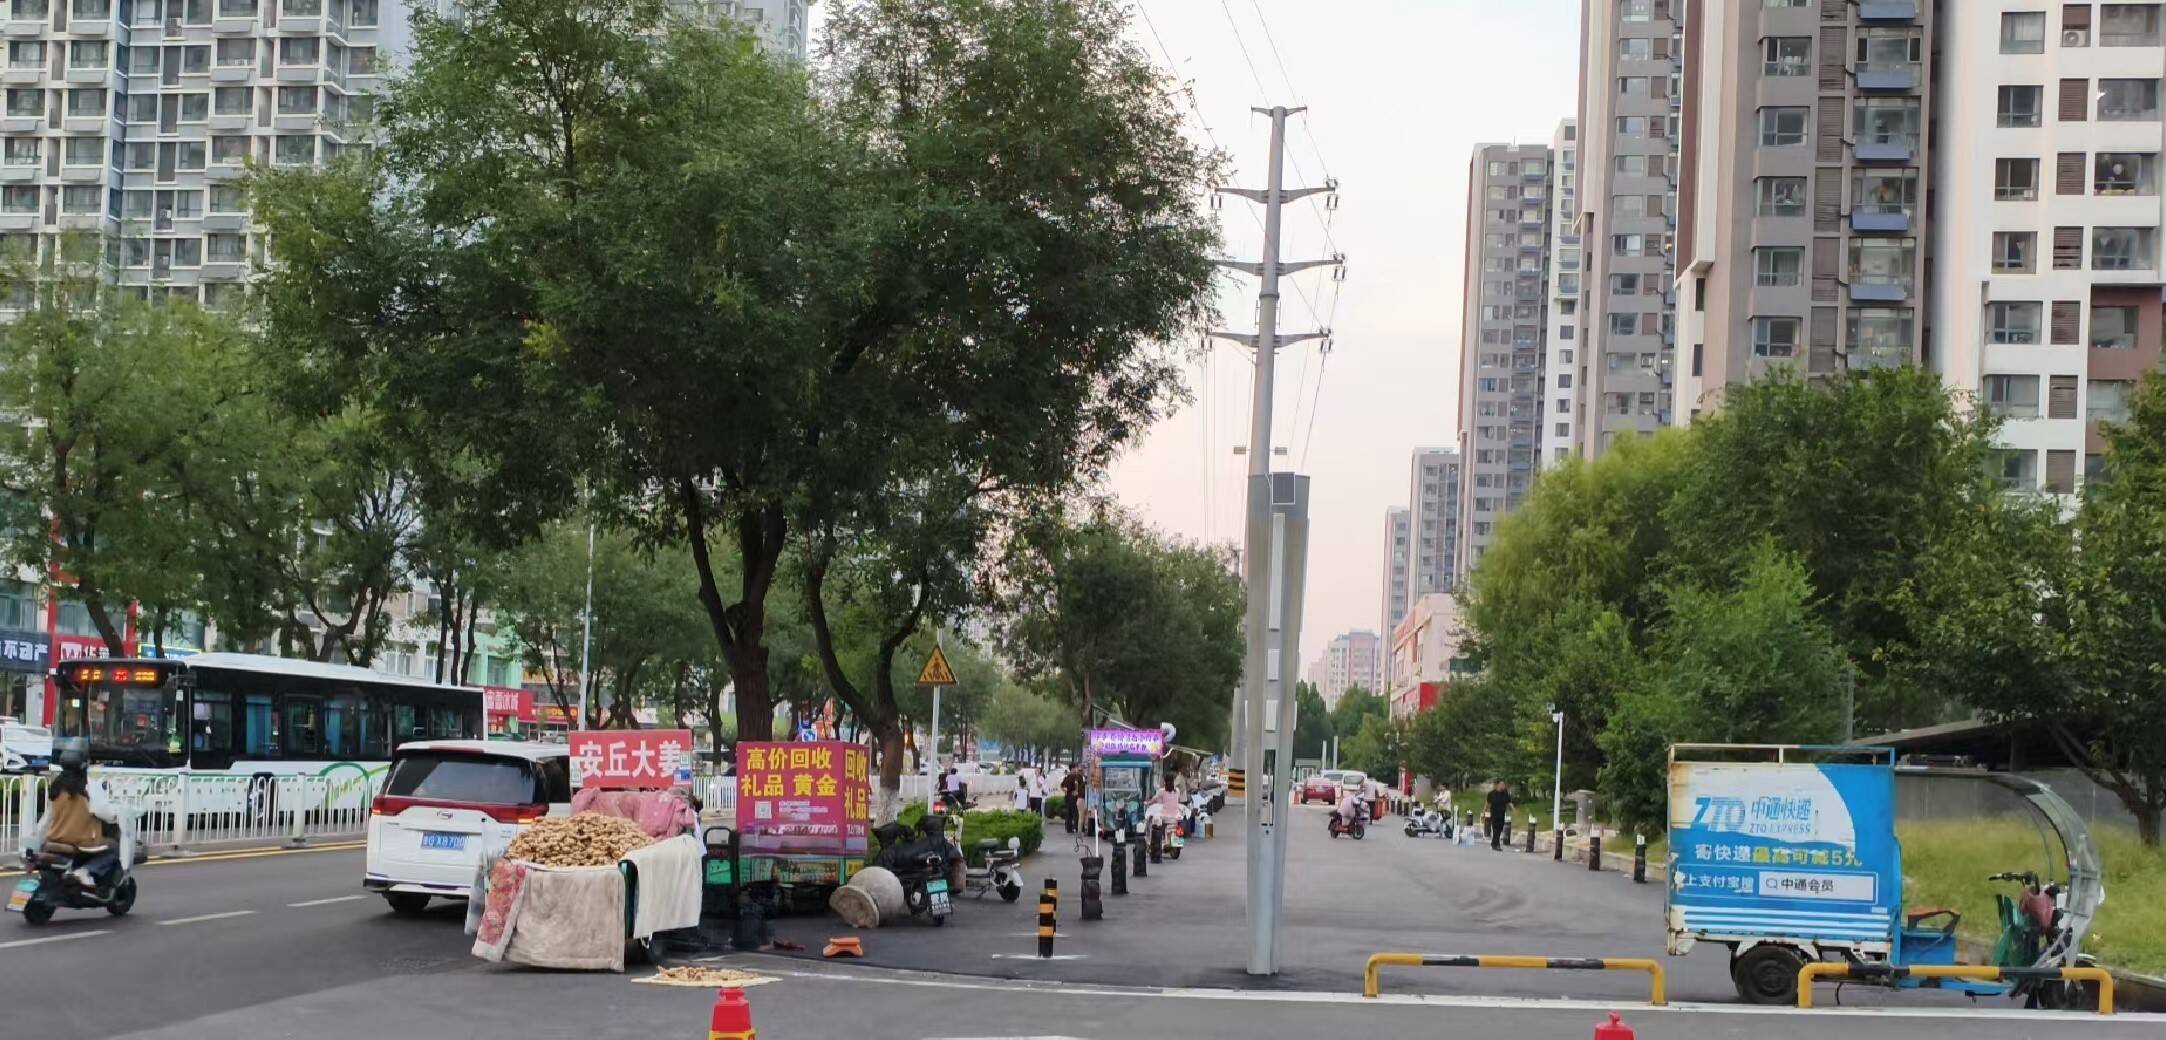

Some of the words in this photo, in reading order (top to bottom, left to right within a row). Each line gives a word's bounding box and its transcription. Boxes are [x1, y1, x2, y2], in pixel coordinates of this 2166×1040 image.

[579, 740, 681, 777] 安丘大姜
[747, 747, 832, 770] 高价回收
[845, 749, 867, 782] 回收
[741, 774, 784, 796] 礼品
[793, 774, 837, 796] 黄金
[845, 786, 866, 819] 礼品
[1691, 796, 1745, 832] ZTO
[1752, 796, 1811, 820] 中通快递
[1781, 879, 1834, 893] 中通会员
